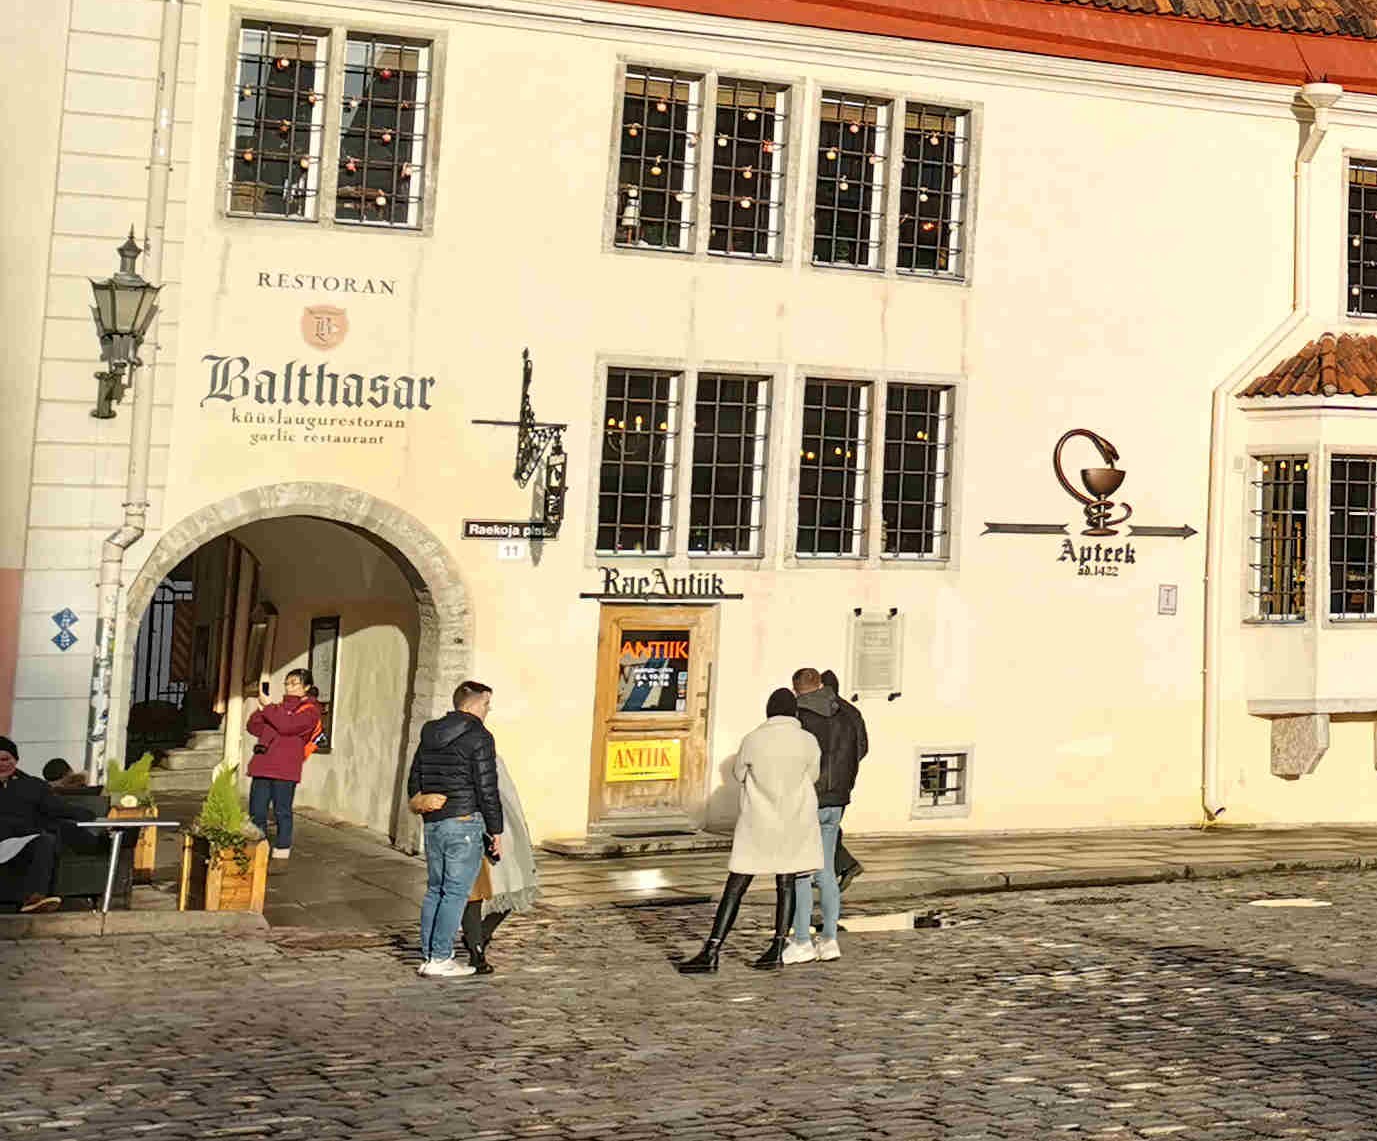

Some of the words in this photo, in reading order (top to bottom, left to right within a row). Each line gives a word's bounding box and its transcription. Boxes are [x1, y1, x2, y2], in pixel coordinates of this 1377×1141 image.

[257, 271, 396, 295] RESTORAN
[200, 354, 436, 410] Balthasar
[231, 407, 406, 431] küüslaugurestoran
[249, 428, 297, 446] garlic
[303, 431, 385, 445] restaurant
[469, 524, 520, 538] Raekoja
[523, 524, 548, 538] plat
[503, 545, 519, 557] 11
[1056, 539, 1136, 566] Apteek
[620, 641, 689, 659] ANTIIK
[612, 748, 671, 768] ANTIIK
